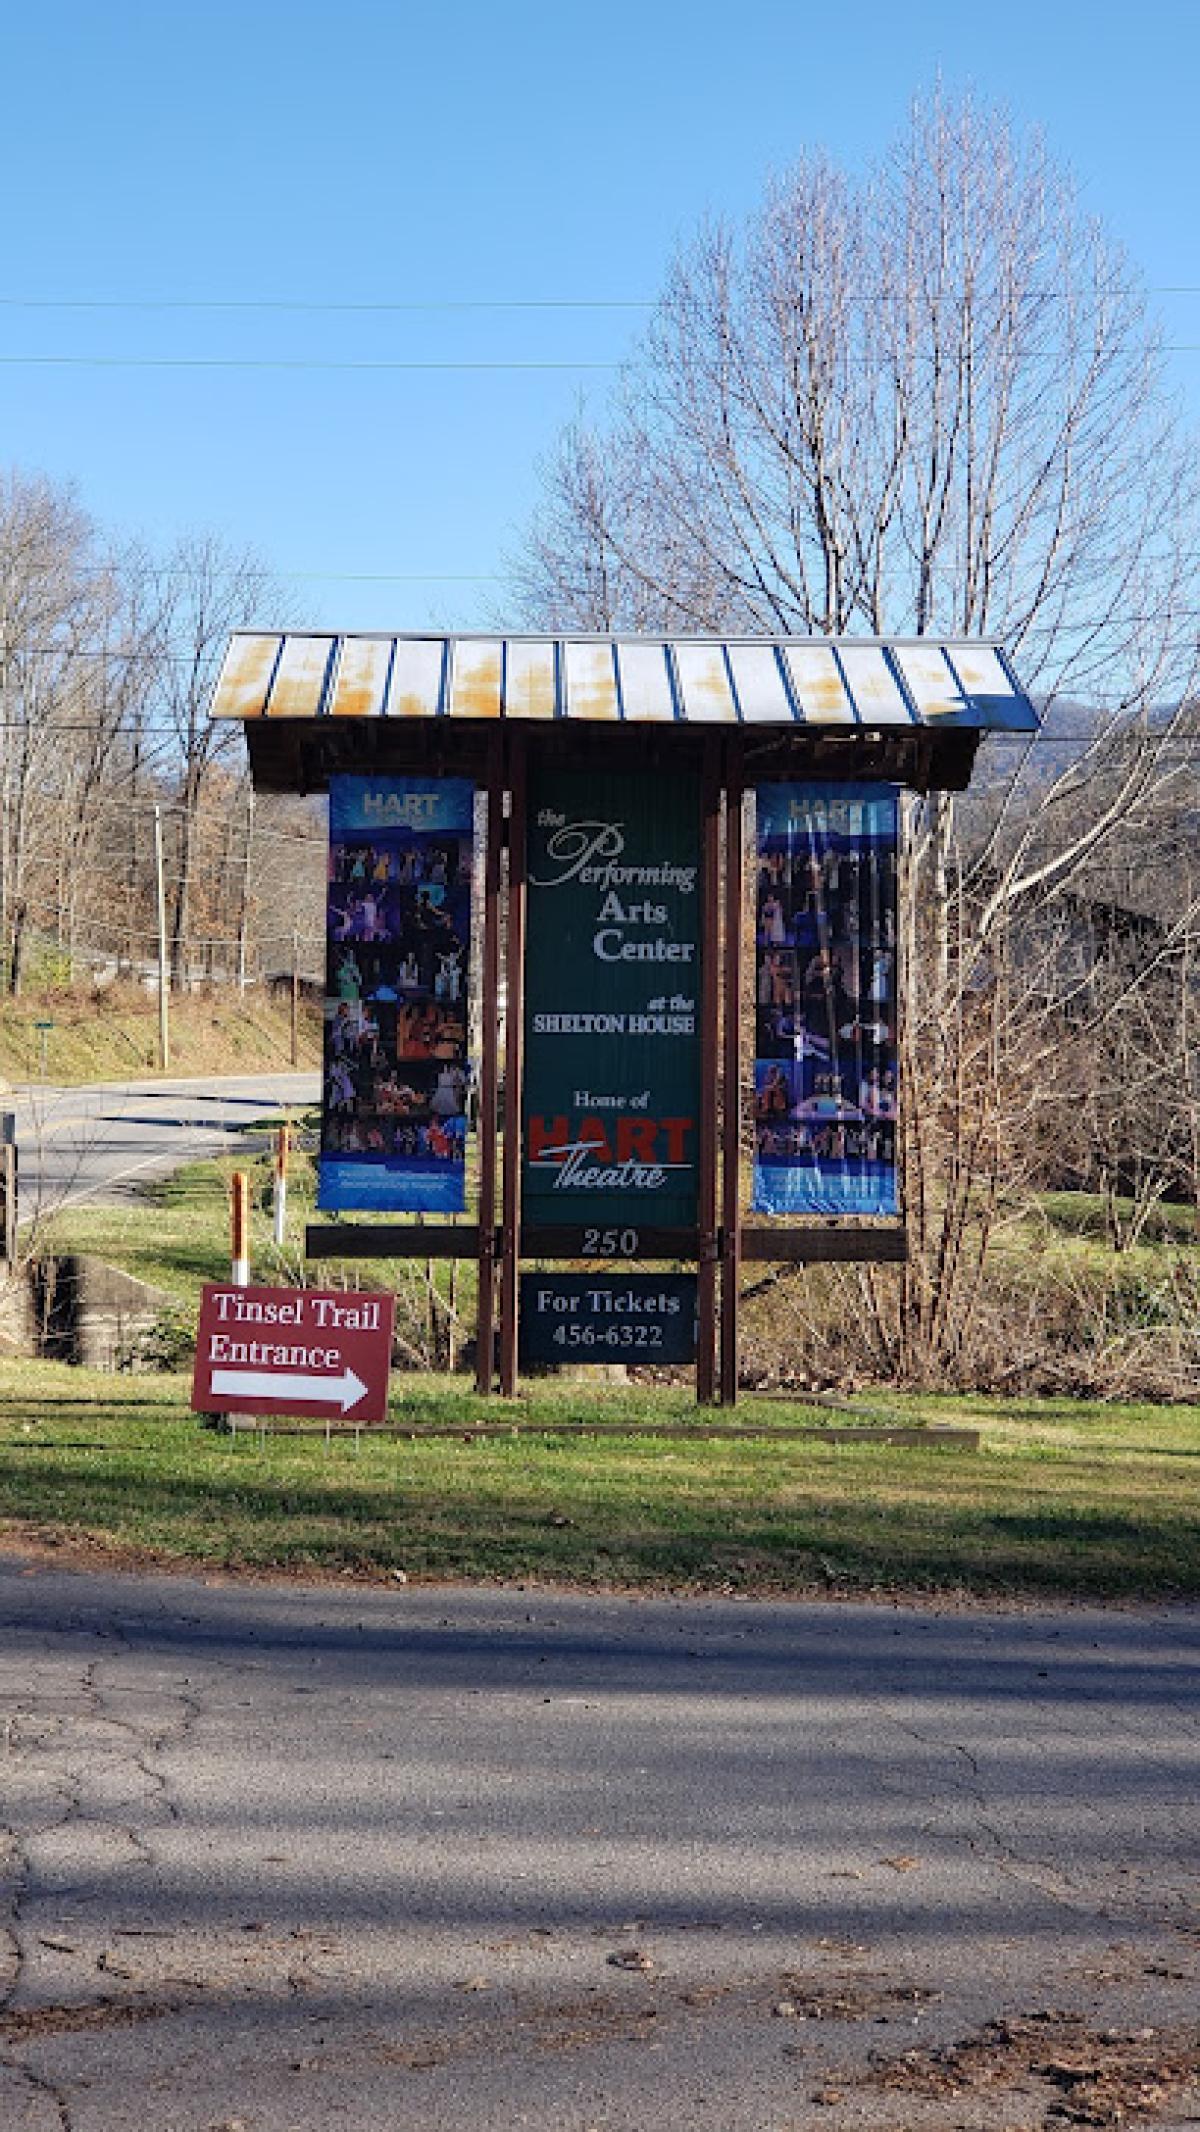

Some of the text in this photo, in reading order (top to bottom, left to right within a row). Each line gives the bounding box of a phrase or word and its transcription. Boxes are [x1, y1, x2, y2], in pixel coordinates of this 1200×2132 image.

[364, 793, 439, 817] HART
[537, 809, 566, 827] the
[529, 820, 698, 894] Performing
[596, 890, 668, 923] Arts
[593, 928, 694, 962] Center
[647, 994, 694, 1012] at the
[533, 1013, 695, 1033] SHELTON HOUSE
[574, 1090, 650, 1109] Home of
[528, 1115, 693, 1163] HART
[538, 1140, 668, 1189] Theatre
[582, 1228, 639, 1255] 250
[212, 1293, 380, 1330] Tinsel Trail
[537, 1290, 680, 1314] For Tickets
[553, 1325, 663, 1347] 456-6322
[208, 1334, 341, 1368] Entrance
